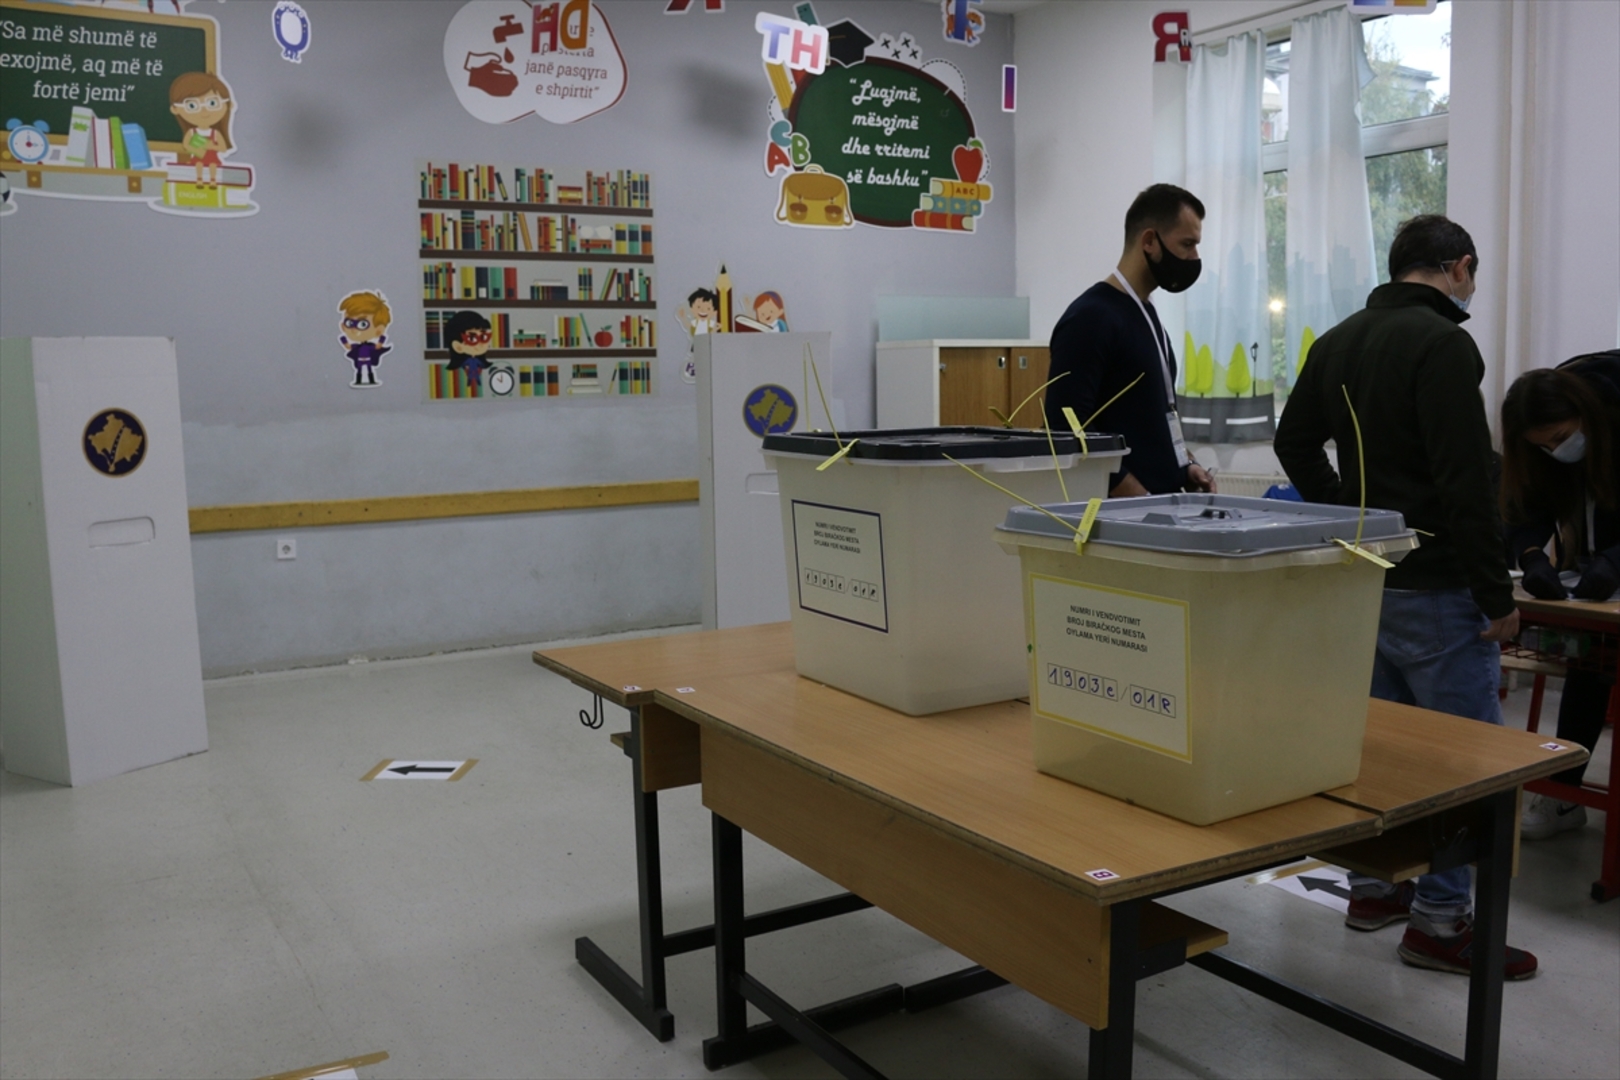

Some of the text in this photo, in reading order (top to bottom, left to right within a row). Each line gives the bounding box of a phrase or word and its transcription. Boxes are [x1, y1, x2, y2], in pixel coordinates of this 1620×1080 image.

[32, 25, 64, 43] më
[69, 26, 135, 47] shumë
[140, 30, 158, 48] të
[761, 21, 822, 69] TH
[82, 58, 106, 77] aq
[110, 58, 141, 75] më
[146, 59, 163, 76] të
[524, 59, 607, 81] janë pasqyra
[32, 80, 135, 104] fortë jemi”
[535, 84, 543, 95] e
[852, 112, 919, 136] mësojmë
[841, 136, 930, 159] dhe rritemi
[847, 168, 864, 184] së
[955, 186, 975, 196] ABC
[1070, 605, 1091, 616] NUMRI
[1096, 610, 1141, 626] VENDVOTIMIT
[1067, 615, 1146, 640] BROJ BIRAČKOG MESTA
[1066, 627, 1094, 640] OYLAMA
[1111, 637, 1149, 653] NUMARASI
